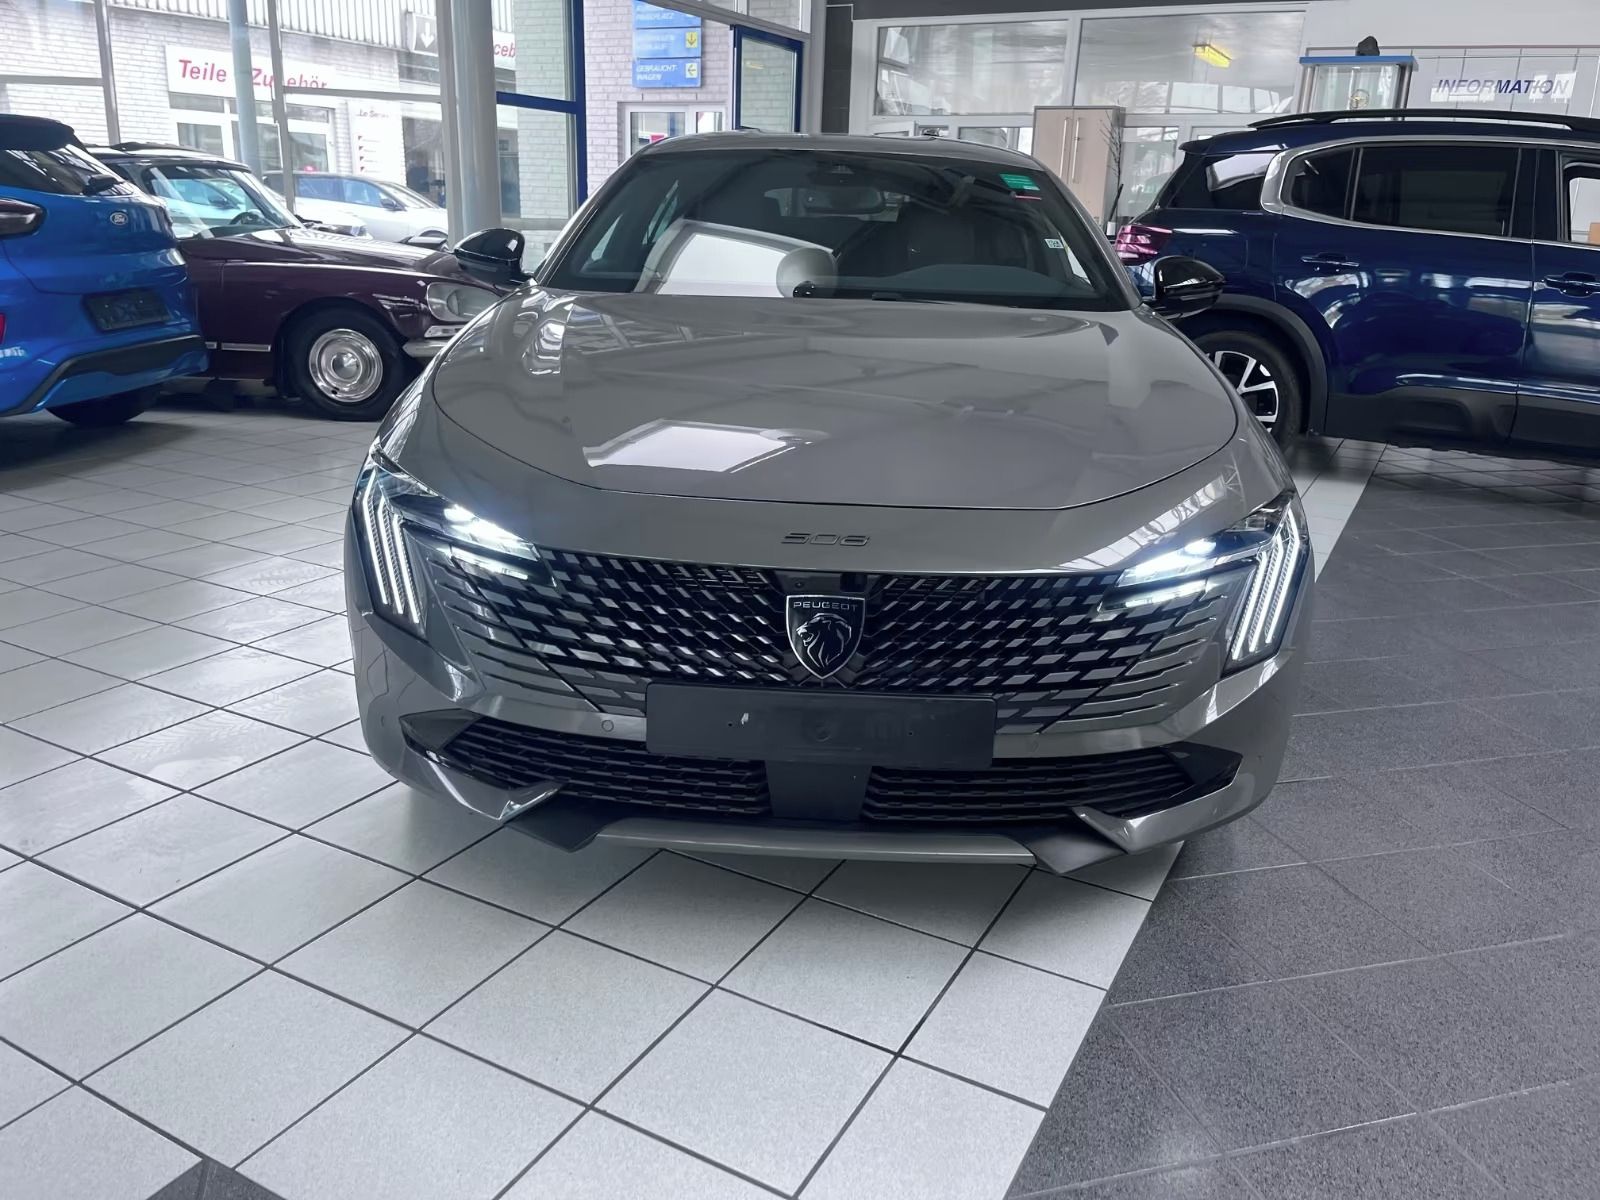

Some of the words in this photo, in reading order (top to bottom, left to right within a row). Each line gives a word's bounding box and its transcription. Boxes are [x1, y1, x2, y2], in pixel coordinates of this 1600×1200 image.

[178, 58, 227, 82] Teile
[250, 67, 328, 88] Zuehör
[1436, 79, 1570, 94] INFORMATION
[781, 532, 870, 547] 508
[792, 600, 859, 612] PEUGEOT
